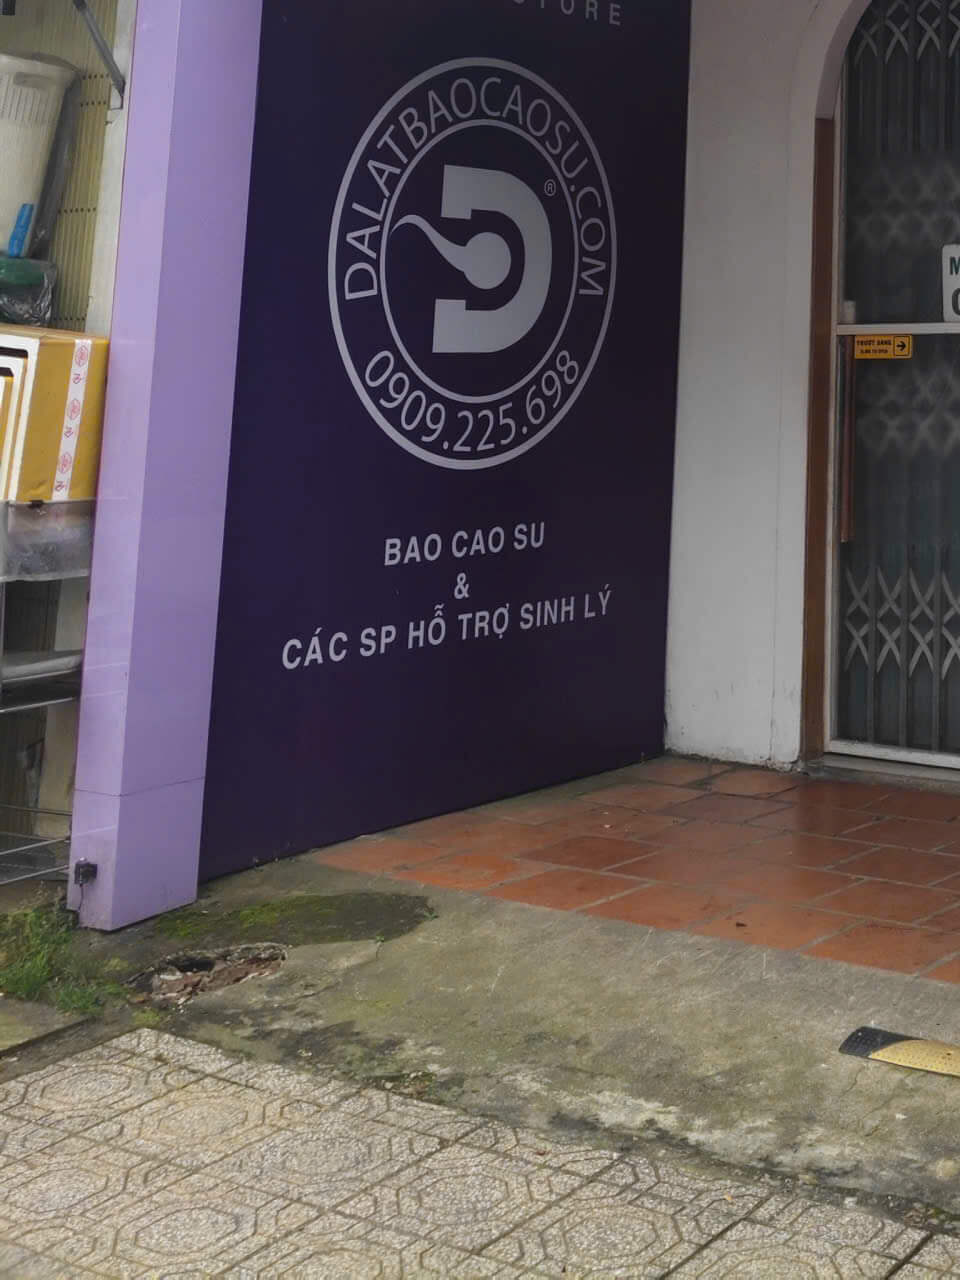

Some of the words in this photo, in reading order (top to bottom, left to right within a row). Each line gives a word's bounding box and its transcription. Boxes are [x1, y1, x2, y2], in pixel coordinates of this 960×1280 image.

[364, 350, 580, 453] 0909.225.698
[383, 532, 442, 567] BAO
[451, 525, 505, 559] CAO
[513, 521, 546, 551] SU
[453, 572, 470, 600] &
[281, 626, 348, 670] CÁC
[359, 624, 397, 657] SP
[407, 603, 447, 650] HỖ
[457, 602, 511, 640] TRỢ
[519, 595, 576, 630] SINH
[584, 583, 612, 618] LÝ
